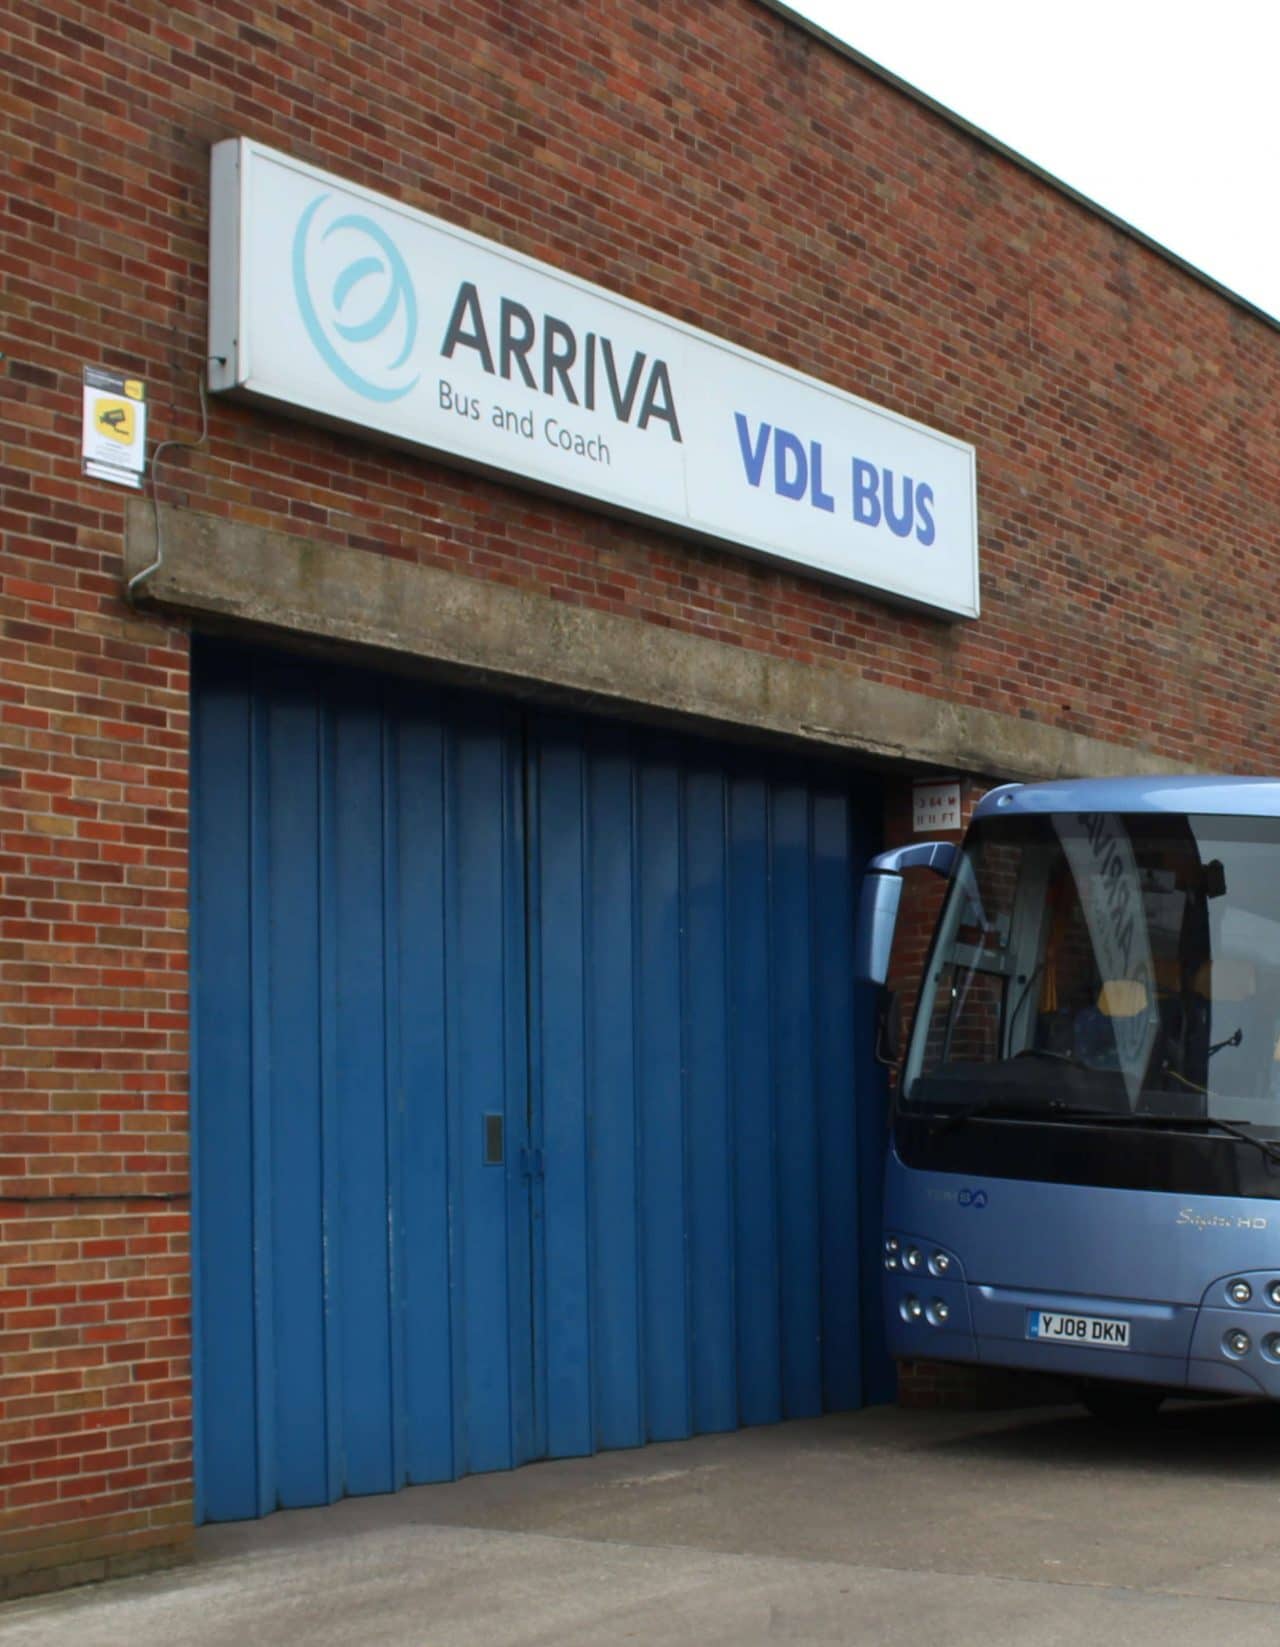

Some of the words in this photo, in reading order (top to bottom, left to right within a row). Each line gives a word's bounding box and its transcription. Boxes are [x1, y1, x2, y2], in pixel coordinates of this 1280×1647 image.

[440, 281, 683, 444] ARRIVA
[439, 380, 481, 421] Bus
[492, 403, 534, 439] and
[544, 418, 611, 465] Coach
[734, 411, 835, 514] VDL
[852, 456, 936, 547] BUS
[1042, 1315, 1087, 1338] YJ08
[1092, 1321, 1126, 1342] DKN
